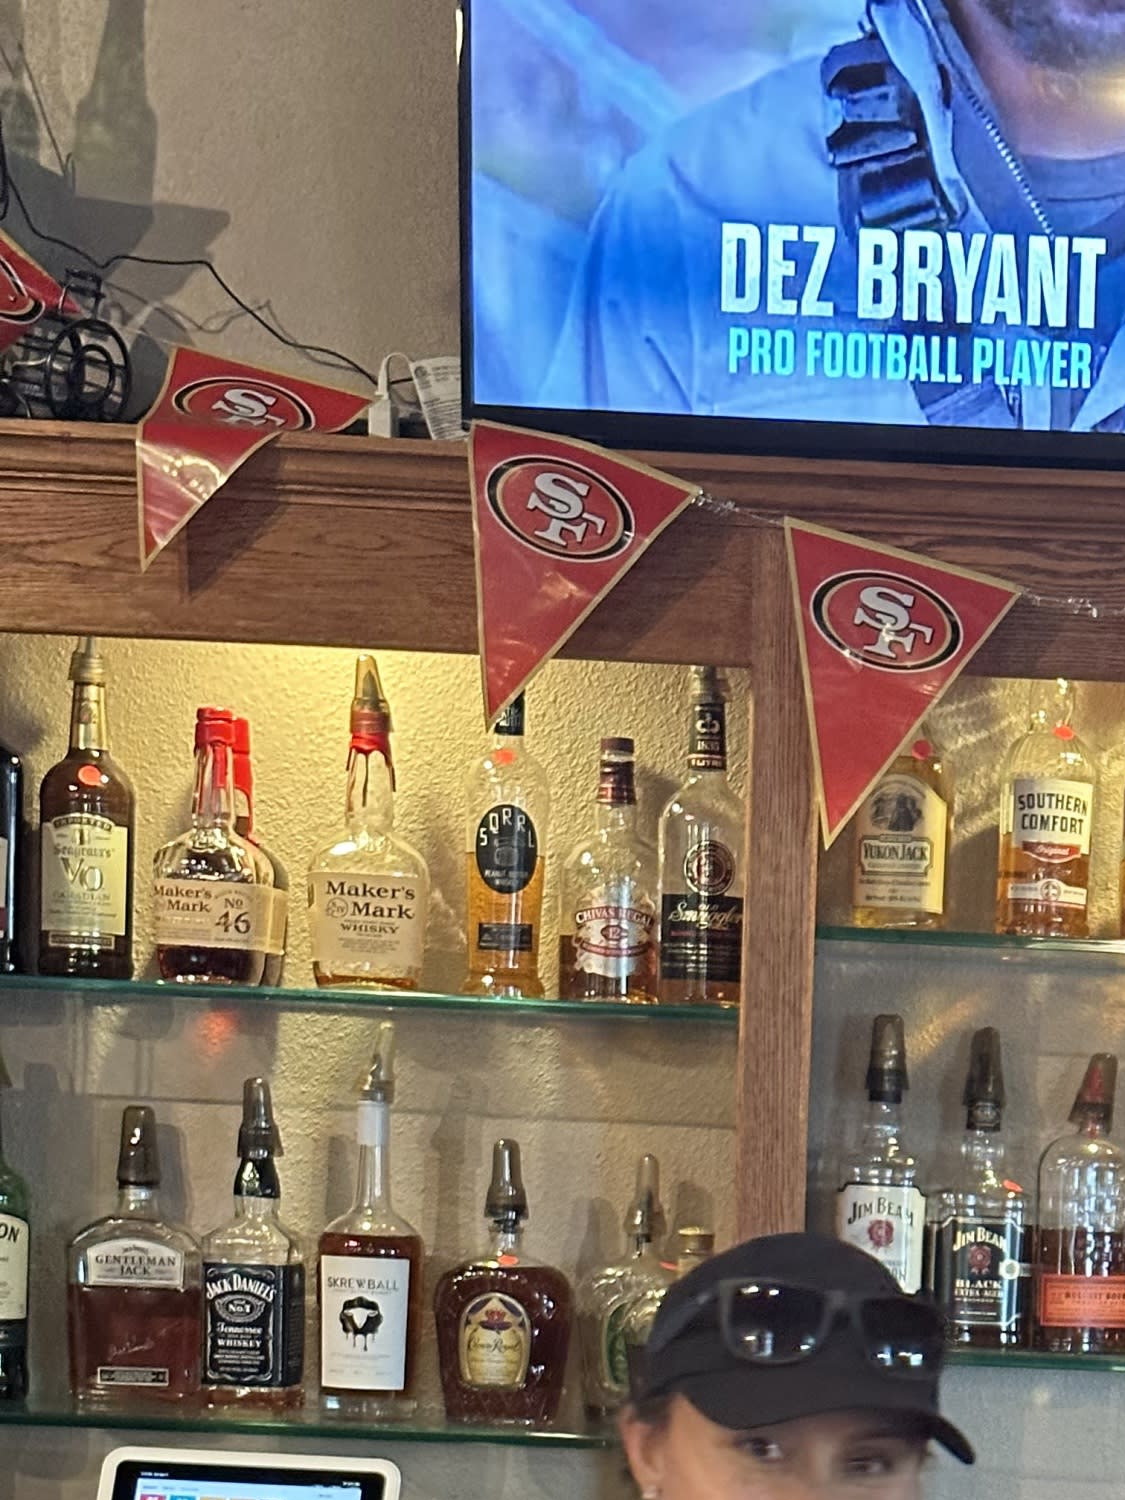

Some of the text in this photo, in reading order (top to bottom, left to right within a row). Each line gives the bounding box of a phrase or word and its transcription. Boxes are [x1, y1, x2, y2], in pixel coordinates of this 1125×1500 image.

[720, 221, 1107, 329] DEZ BRYANT
[728, 326, 1093, 389] PRO FOOTBALL PLAYER
[1018, 792, 1088, 816] SOUTHERN
[1021, 813, 1085, 835] COMFORT
[863, 843, 928, 861] YUKON JACK
[61, 857, 103, 892] VO
[154, 884, 213, 899] Maker's
[325, 880, 416, 901] Maker's
[167, 900, 212, 913] Mark
[350, 902, 416, 920] Mark
[215, 911, 251, 934] 46
[575, 906, 655, 928] CHIVAS REGAL
[340, 923, 400, 934] WHISKY
[848, 1197, 914, 1227] JIM BEAM
[953, 1226, 1007, 1251] JIM BEAM
[95, 1254, 176, 1266] GENTLEMAN
[119, 1266, 151, 1276] JACK
[206, 1273, 277, 1302] JACK DANIEL'S
[327, 1276, 400, 1291] SKREWBALL
[955, 1279, 1002, 1289] BLACK
[215, 1322, 263, 1334] Tennessee
[217, 1339, 262, 1348] WHISKEY
